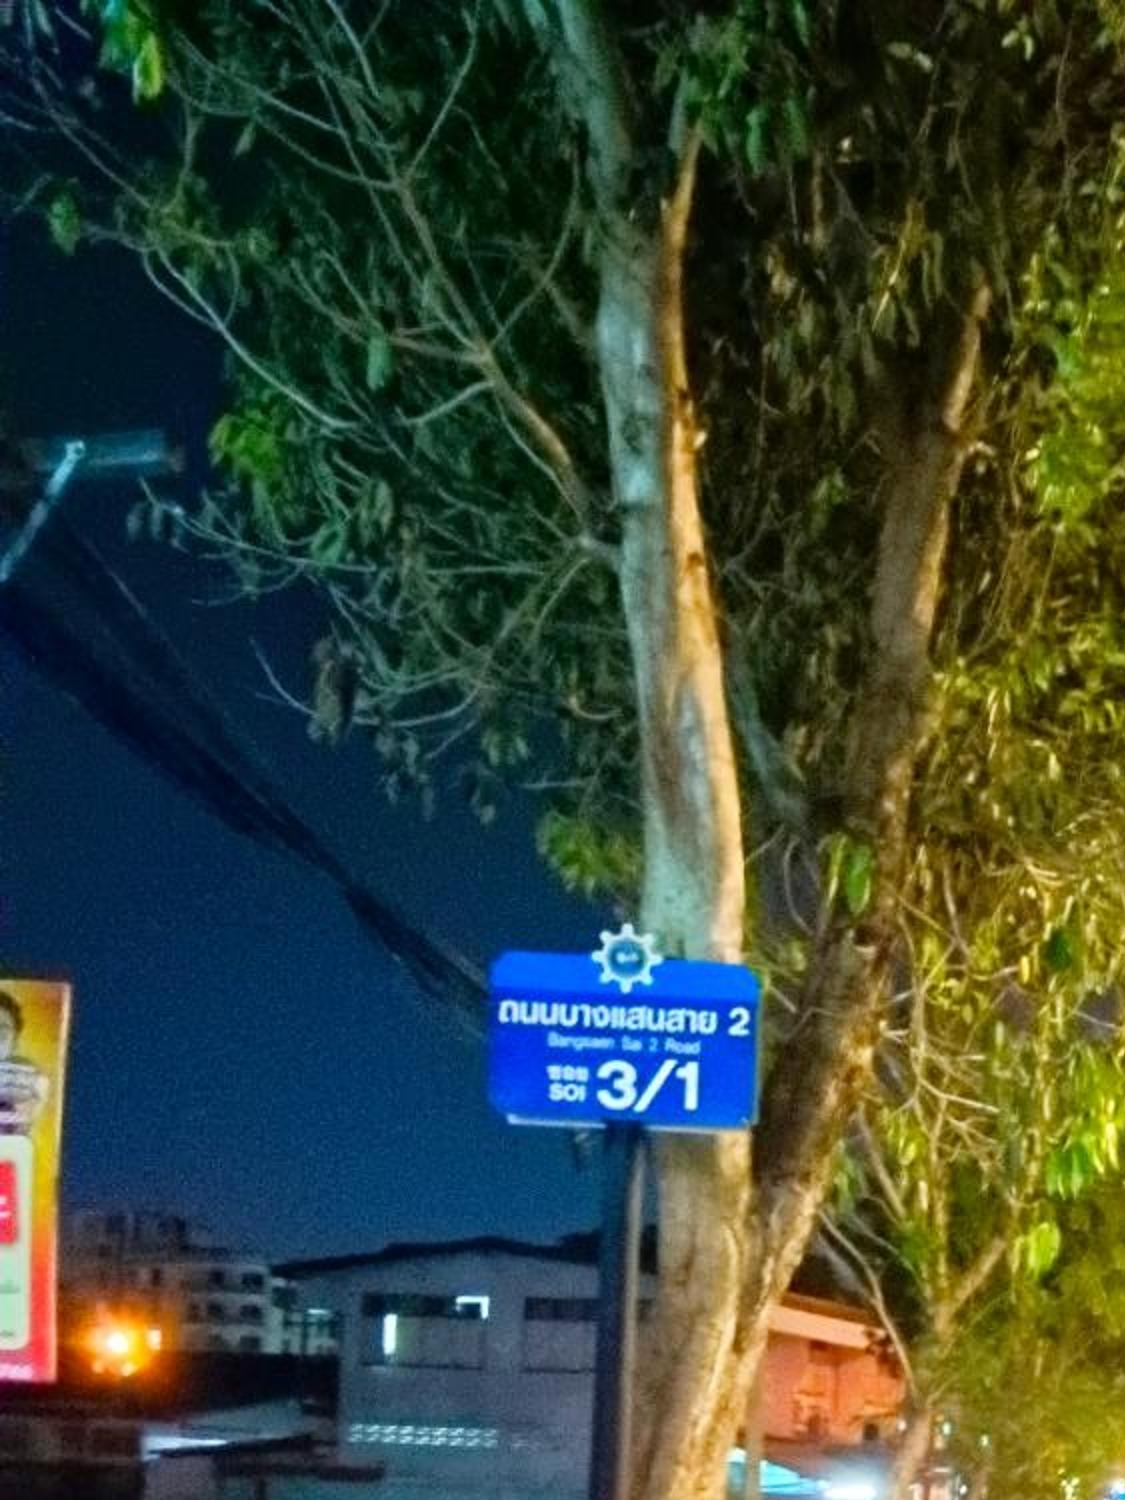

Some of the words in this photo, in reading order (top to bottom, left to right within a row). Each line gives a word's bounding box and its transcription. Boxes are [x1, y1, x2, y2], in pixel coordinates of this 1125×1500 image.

[498, 999, 717, 1034] ถนนบางแสนสาย
[728, 1007, 750, 1036] 2
[597, 1060, 699, 1112] 3/1
